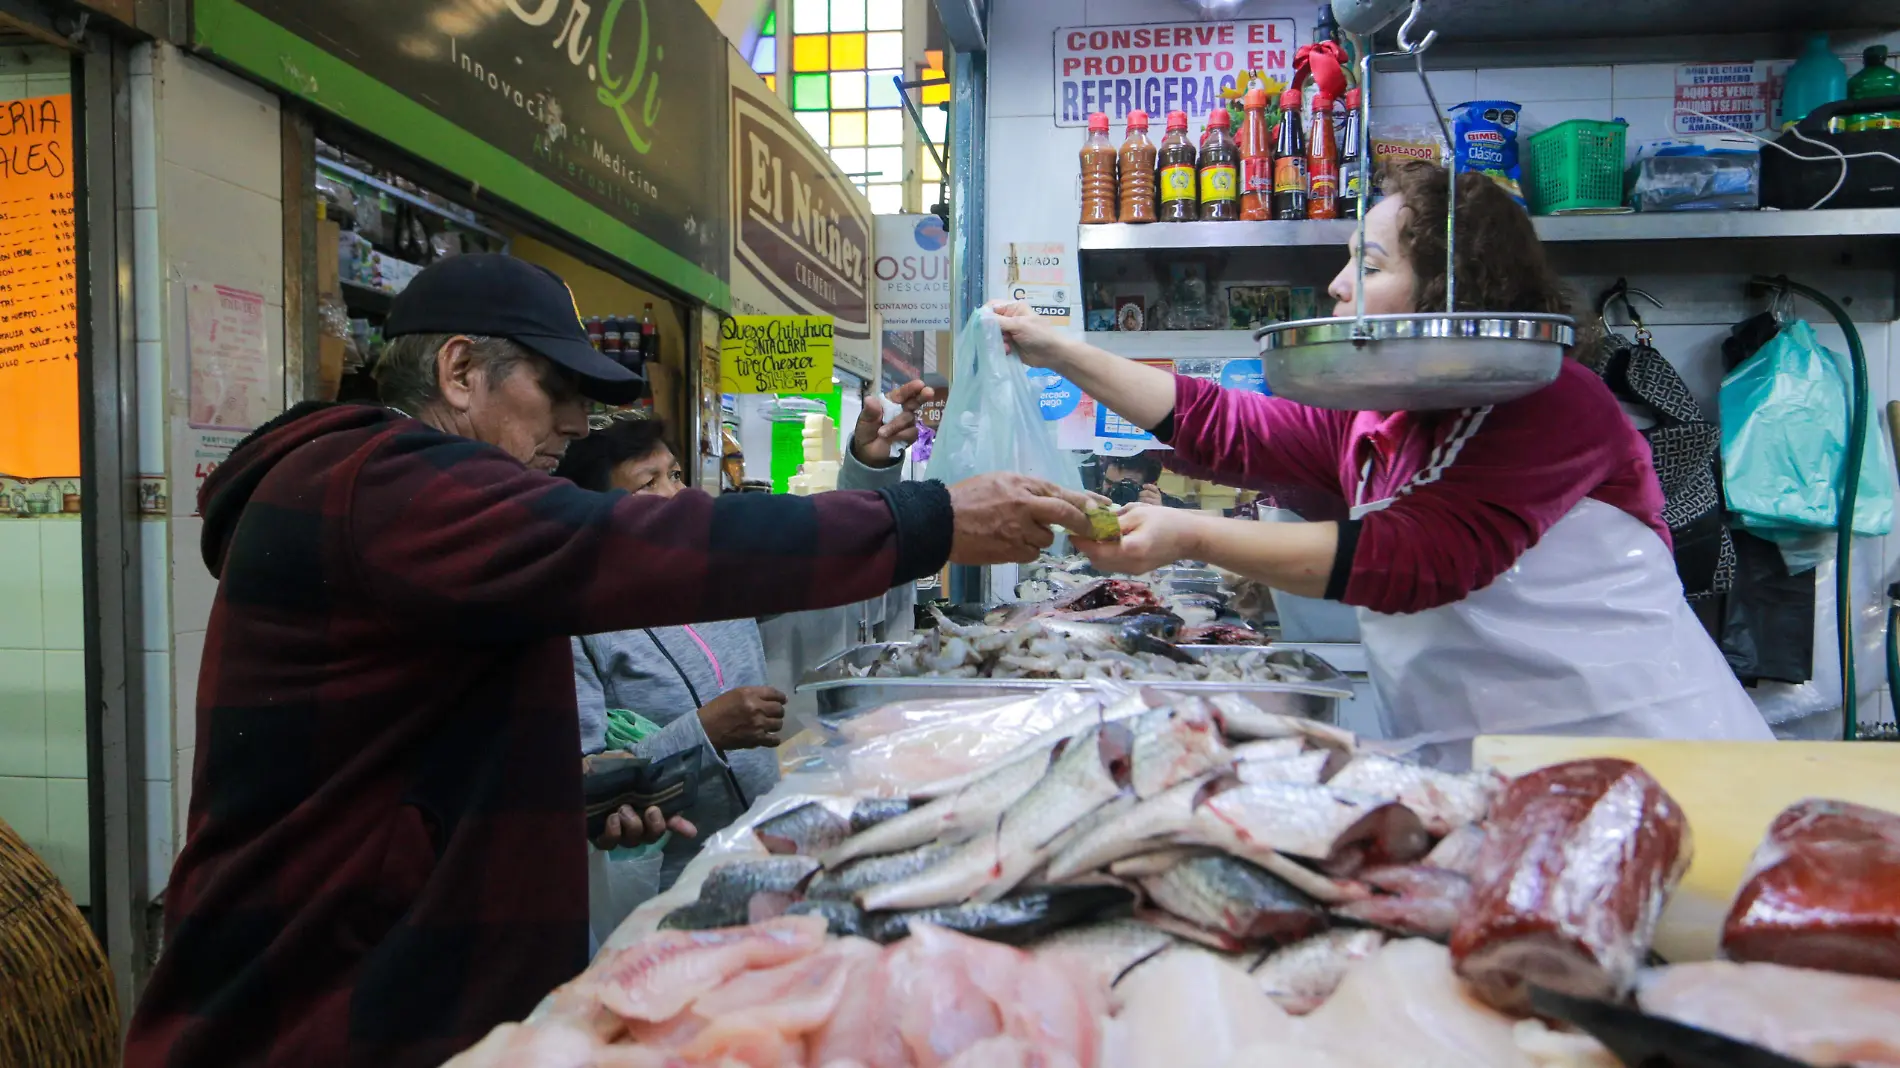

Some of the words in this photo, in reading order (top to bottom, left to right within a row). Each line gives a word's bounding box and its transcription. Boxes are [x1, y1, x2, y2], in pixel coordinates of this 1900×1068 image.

[1066, 26, 1234, 51] CONSERVE
[1248, 24, 1283, 44] EL
[1063, 51, 1234, 77] PRODUCTO
[1248, 50, 1286, 70] EN
[1707, 75, 1750, 83] PRIMERO
[1376, 143, 1432, 160] CAPEADOR
[1468, 147, 1502, 162] Clásico
[593, 140, 658, 199] Medicina
[749, 131, 784, 224] El
[790, 171, 863, 288] Núñez
[719, 315, 765, 340] Queso
[744, 338, 776, 357] SANTA
[777, 338, 807, 354] CLARA
[756, 371, 795, 393] $148
[1040, 390, 1070, 399] ercado
[1040, 398, 1062, 408] pago
